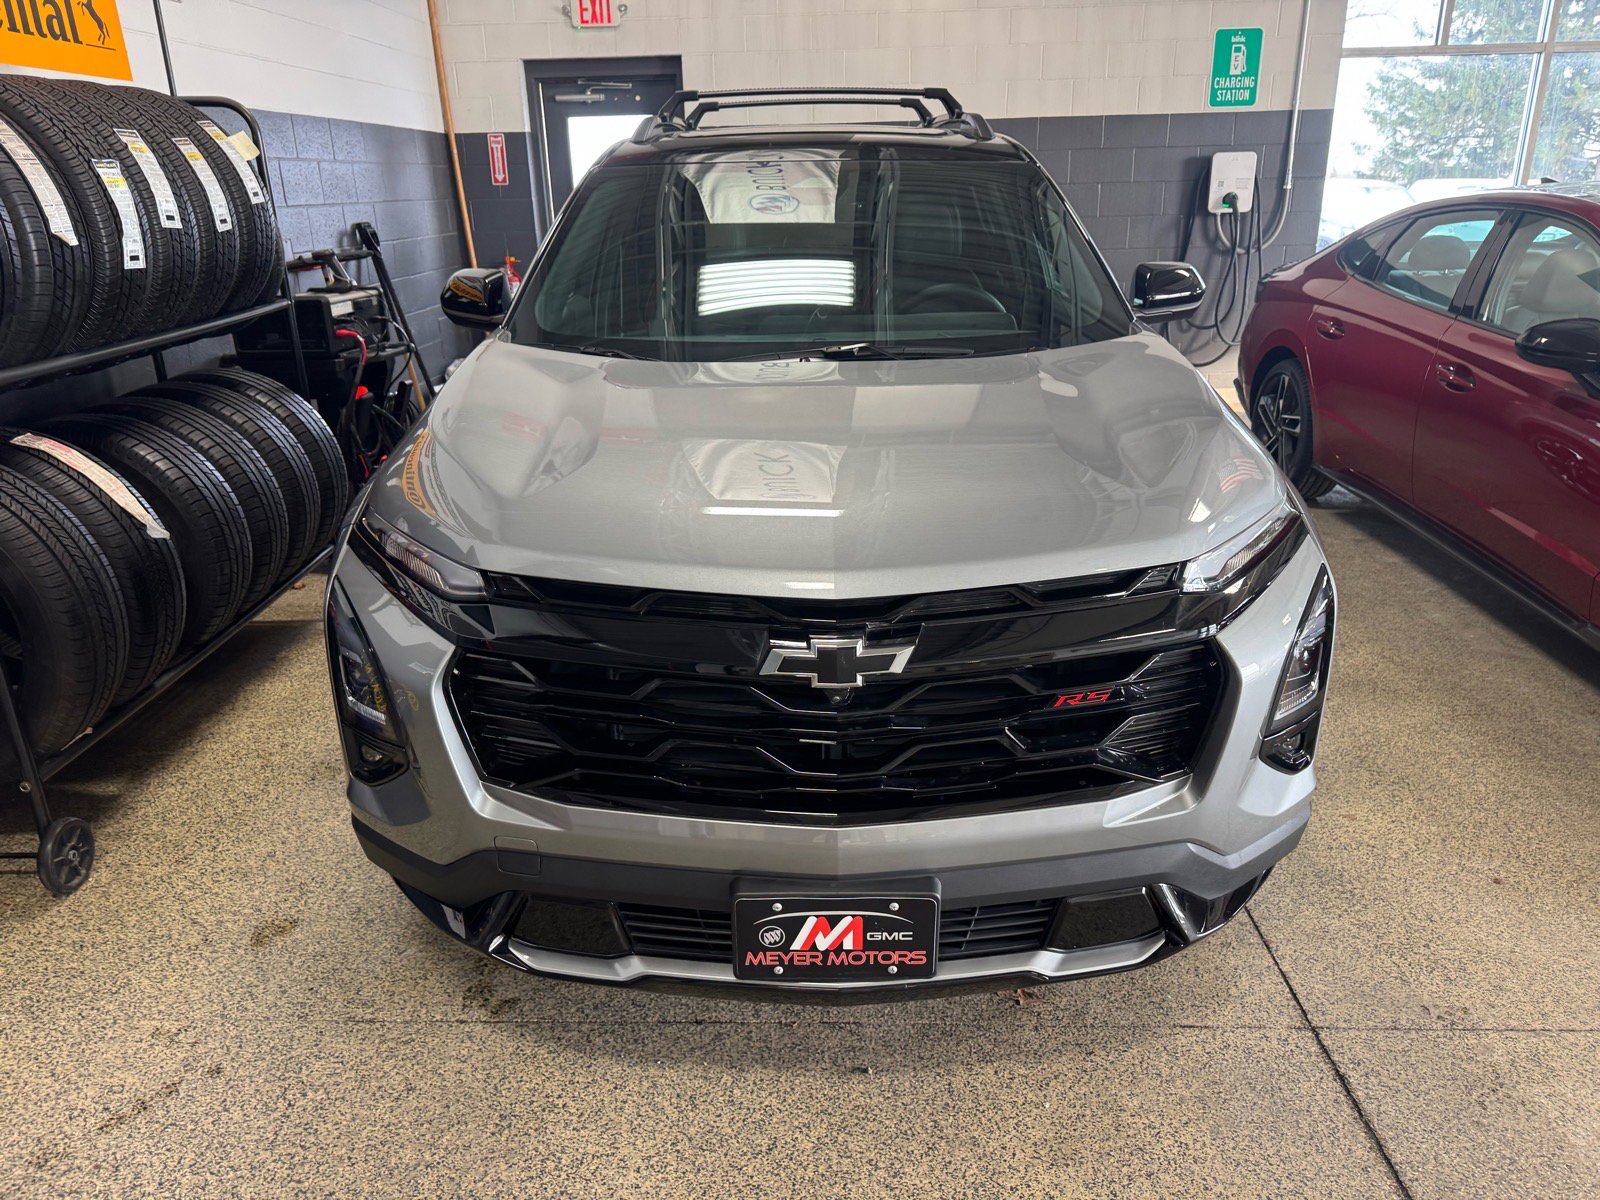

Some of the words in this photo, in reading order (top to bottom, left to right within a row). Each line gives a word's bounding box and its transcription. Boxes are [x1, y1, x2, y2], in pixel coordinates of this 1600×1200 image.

[0, 0, 83, 45] ntal
[1214, 76, 1255, 89] CHARGING
[1216, 89, 1250, 102] STATION
[1053, 689, 1113, 708] RS
[866, 931, 914, 941] GMC
[745, 951, 823, 967] MEYER
[827, 950, 927, 966] MOTORS
